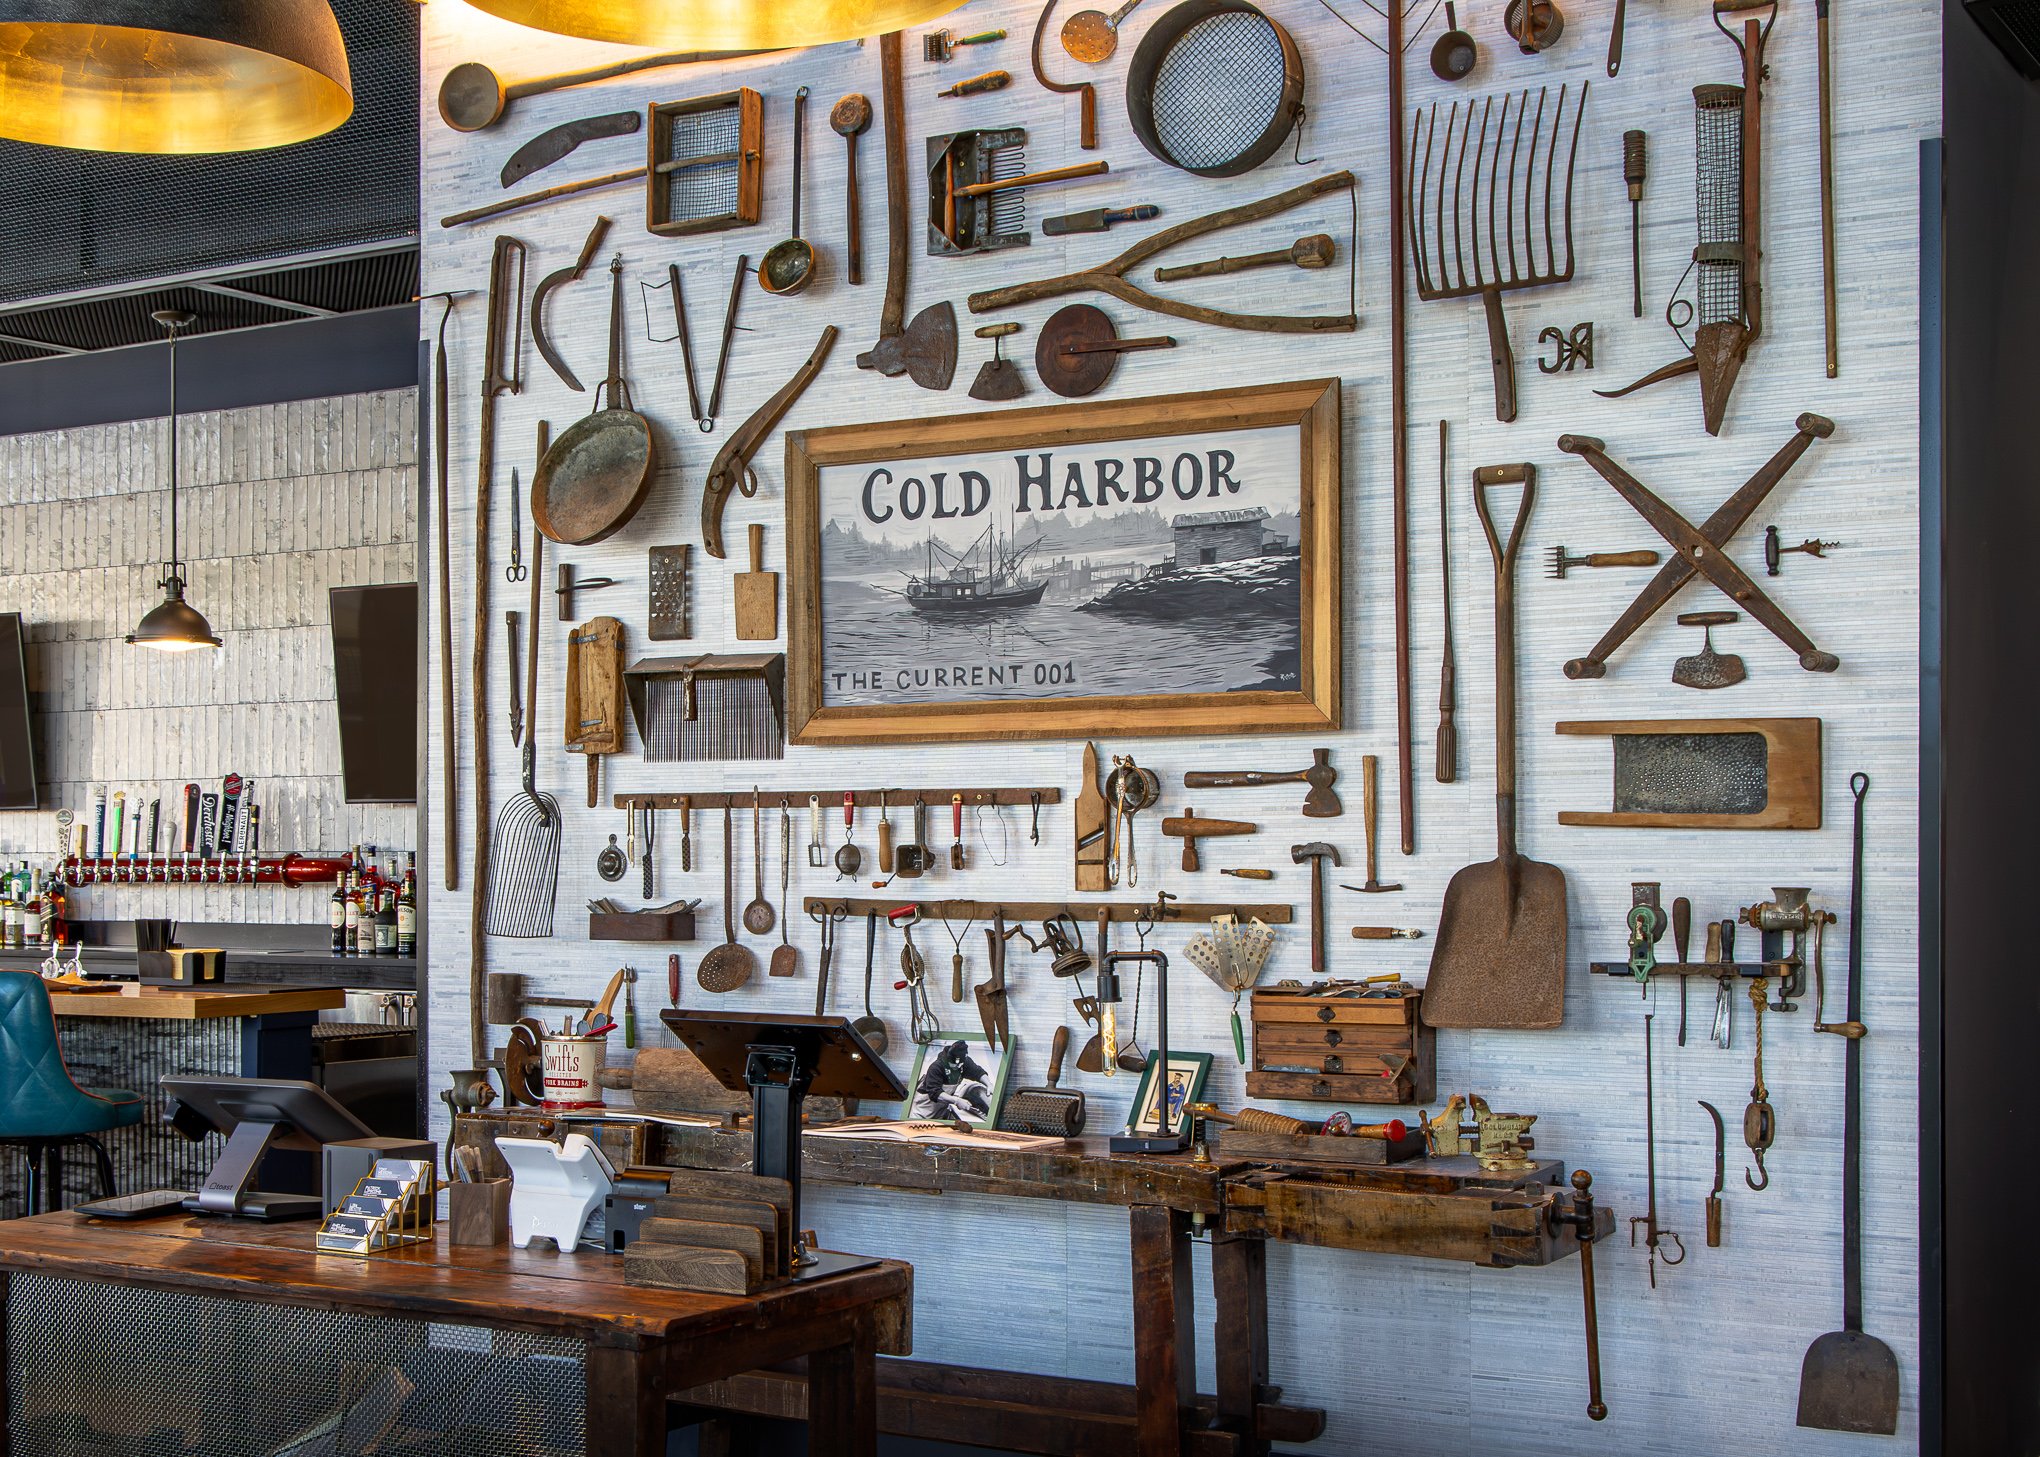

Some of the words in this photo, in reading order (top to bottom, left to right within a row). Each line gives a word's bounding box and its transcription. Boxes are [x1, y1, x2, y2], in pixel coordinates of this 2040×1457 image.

[861, 468, 991, 525] COLD
[1014, 449, 1241, 513] HARBOR
[832, 671, 883, 691] THE
[896, 664, 1024, 690] CURRENT
[1033, 660, 1076, 685] 001
[202, 796, 215, 848] Dorchester
[238, 811, 248, 850] AERONAUT
[544, 1044, 580, 1072] Swift's
[557, 1079, 580, 1087] BRAINS
[215, 1183, 234, 1191] toast
